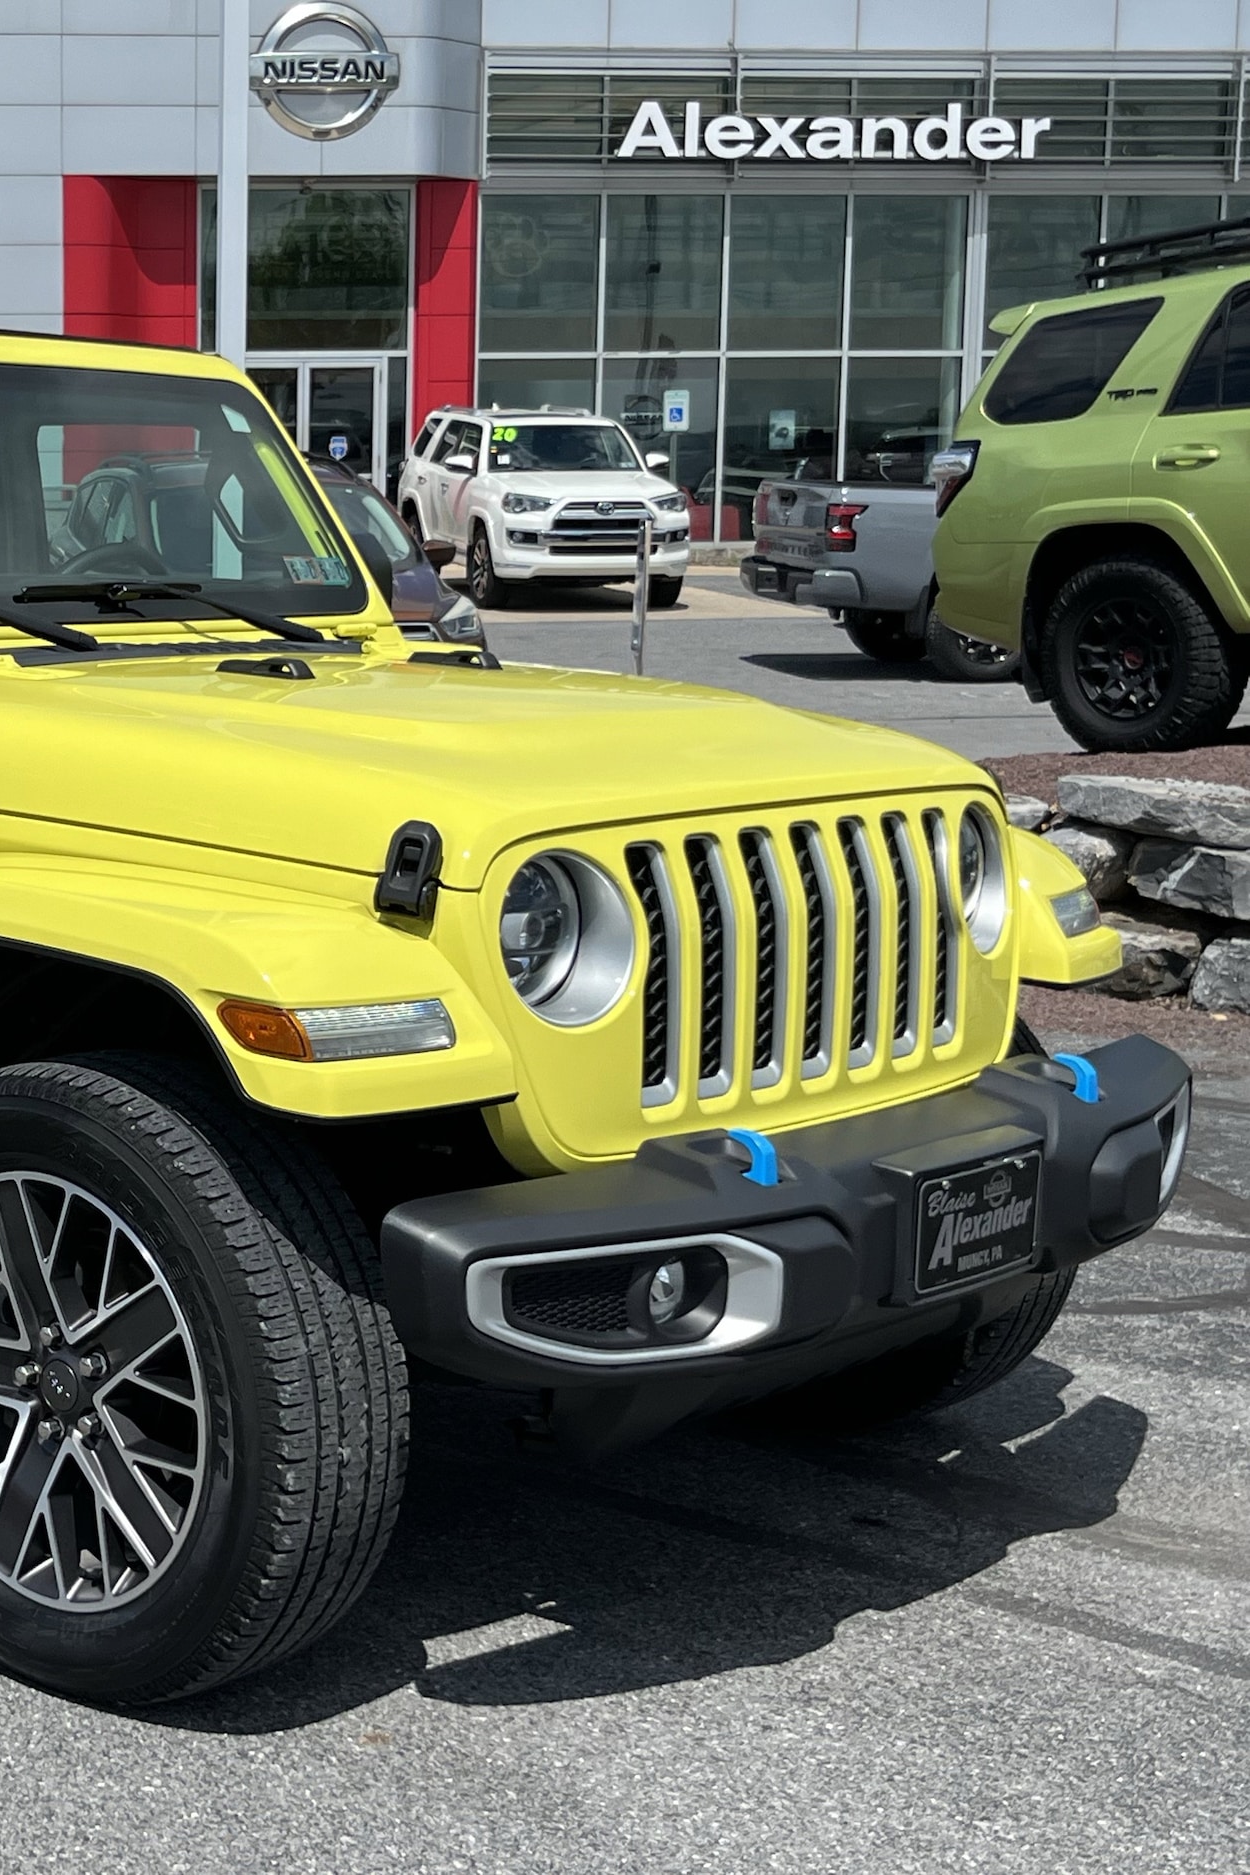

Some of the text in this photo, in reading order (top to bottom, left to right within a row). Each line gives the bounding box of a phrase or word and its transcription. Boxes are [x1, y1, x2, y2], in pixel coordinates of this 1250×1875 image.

[262, 59, 386, 83] NISSAN
[617, 101, 1050, 160] Alexander
[492, 427, 517, 442] 20
[927, 1190, 976, 1217] Blaise
[927, 1196, 1033, 1271] Alexander
[991, 1245, 1003, 1262] PA
